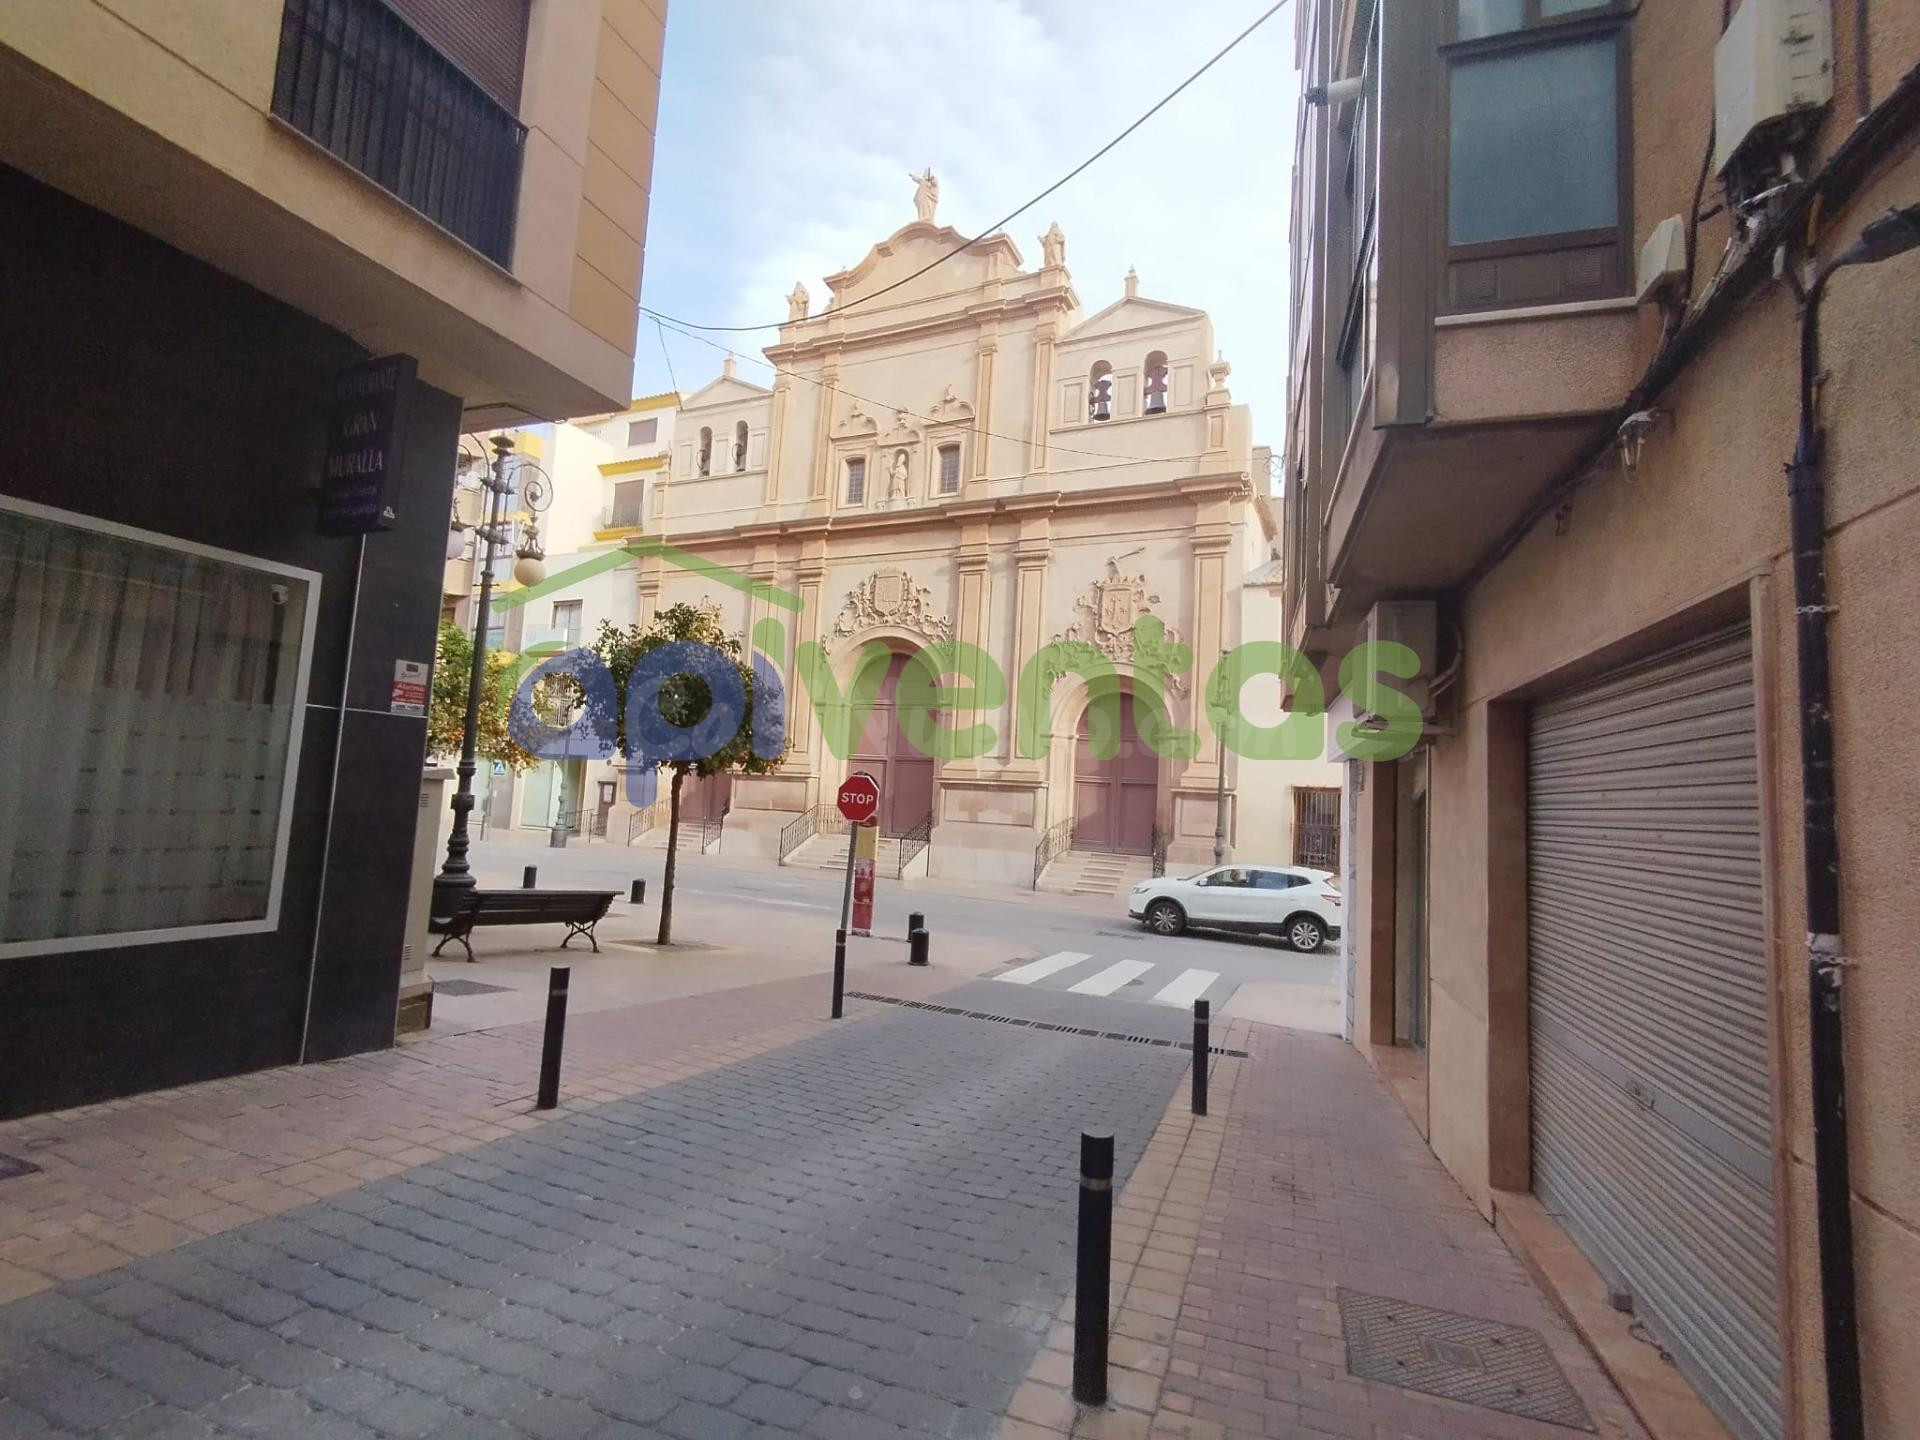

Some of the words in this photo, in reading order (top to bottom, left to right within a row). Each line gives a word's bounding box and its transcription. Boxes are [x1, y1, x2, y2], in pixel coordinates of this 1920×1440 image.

[343, 411, 377, 438] GRAN
[328, 449, 383, 478] MURALLA
[841, 792, 875, 806] STOP
